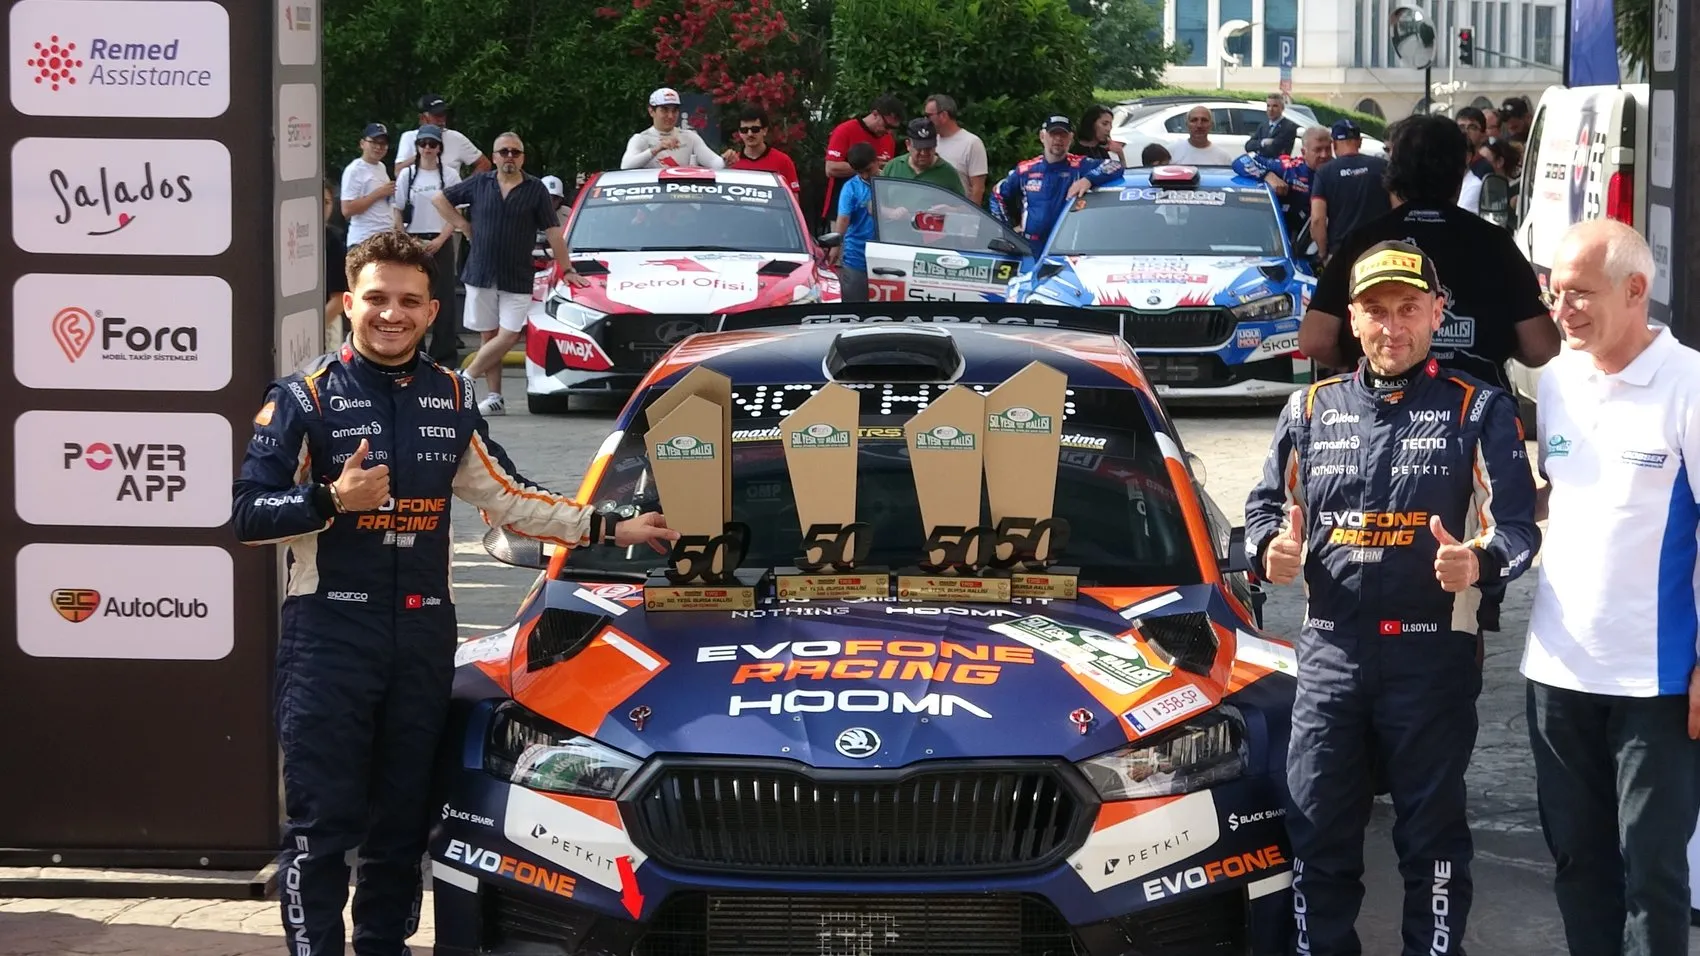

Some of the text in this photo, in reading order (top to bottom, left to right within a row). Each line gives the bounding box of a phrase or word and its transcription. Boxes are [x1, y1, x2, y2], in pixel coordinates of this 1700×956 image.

[90, 39, 179, 61] Remed
[1281, 41, 1290, 64] P
[89, 65, 211, 86] Assistance
[49, 162, 193, 225] Salados
[602, 185, 661, 199] Team
[666, 183, 722, 194] Petrol
[727, 186, 772, 200] Ofisi
[998, 265, 1012, 280] 3
[620, 277, 746, 291] Petrol Ofisi
[102, 318, 198, 351] Fora
[288, 381, 314, 413] sparco
[330, 396, 372, 411] Midea
[1321, 409, 1360, 425] Midea
[332, 424, 371, 438] amazfit
[418, 426, 456, 438] TECNO
[732, 427, 781, 439] maxi
[1060, 433, 1107, 446] xima
[1314, 438, 1351, 450] amazfit
[1401, 437, 1447, 451] TECNO
[64, 442, 187, 472] POWER
[116, 475, 187, 501] APP
[356, 514, 439, 532] RACING
[1320, 511, 1428, 527] EVOFONE
[1329, 529, 1415, 546] RACING
[328, 591, 368, 602] sparco
[104, 597, 208, 618] AutoClub
[731, 606, 1022, 619] NOTHING HOOMA
[1402, 618, 1438, 633] U.SOYLU
[696, 640, 1035, 664] EVOFONE
[731, 660, 1002, 685] RACING
[728, 689, 993, 719] HOOMA
[1157, 690, 1197, 715] 358-SP
[450, 810, 495, 827] BLACK SHARK
[1240, 812, 1265, 825] BLACK
[551, 835, 614, 870] PETKIT
[1127, 830, 1190, 866] PETKIT
[444, 838, 577, 899] EVOFONE
[1142, 844, 1287, 902] EVOFONE
